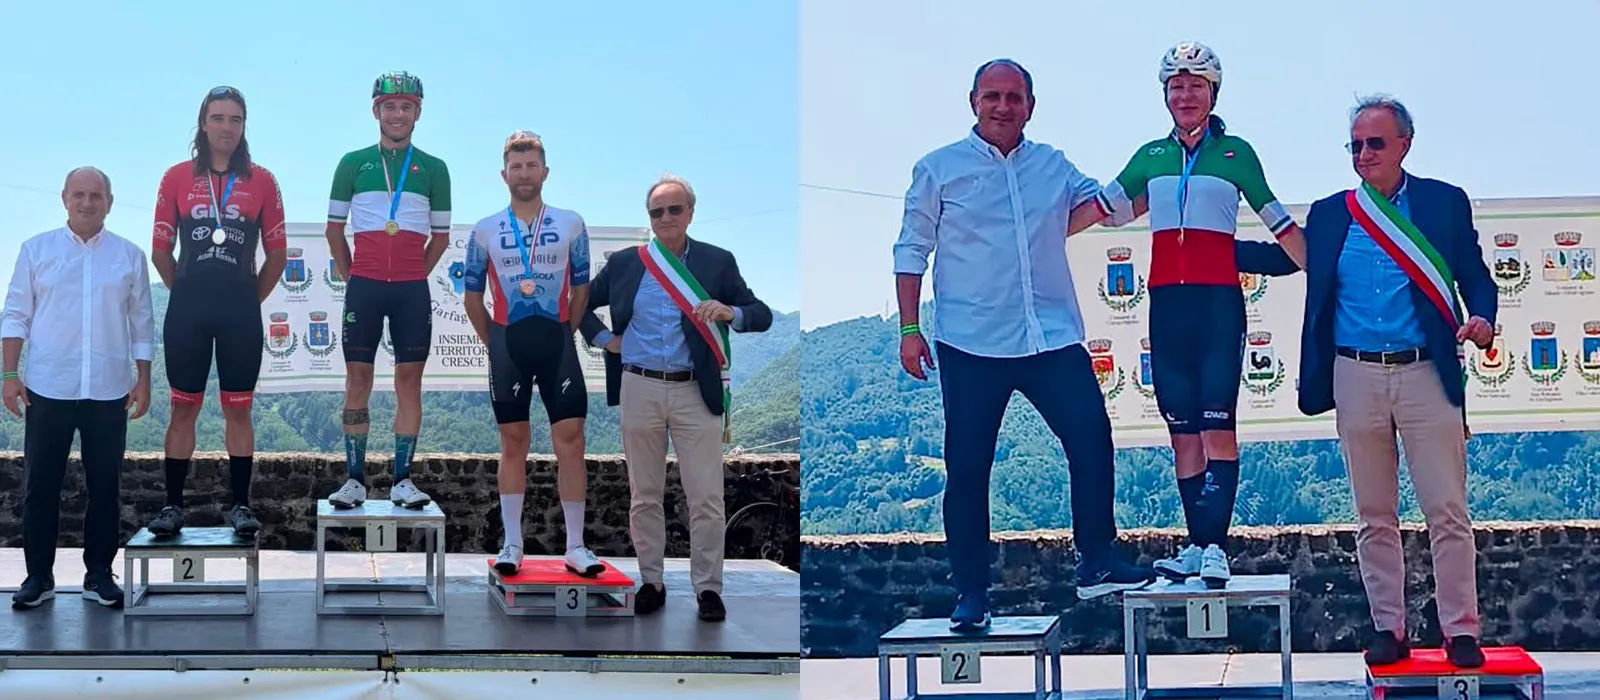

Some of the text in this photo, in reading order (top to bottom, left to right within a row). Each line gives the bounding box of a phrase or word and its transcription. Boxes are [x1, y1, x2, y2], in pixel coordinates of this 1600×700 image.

[430, 299, 468, 324] Garfag
[434, 345, 489, 356] TERRITOR
[441, 357, 485, 367] CRESCE
[377, 524, 384, 546] 1
[182, 557, 194, 580] 2
[566, 588, 578, 610] 3
[1201, 603, 1210, 631] 1
[952, 652, 968, 681] 2
[1454, 679, 1468, 700] 3
